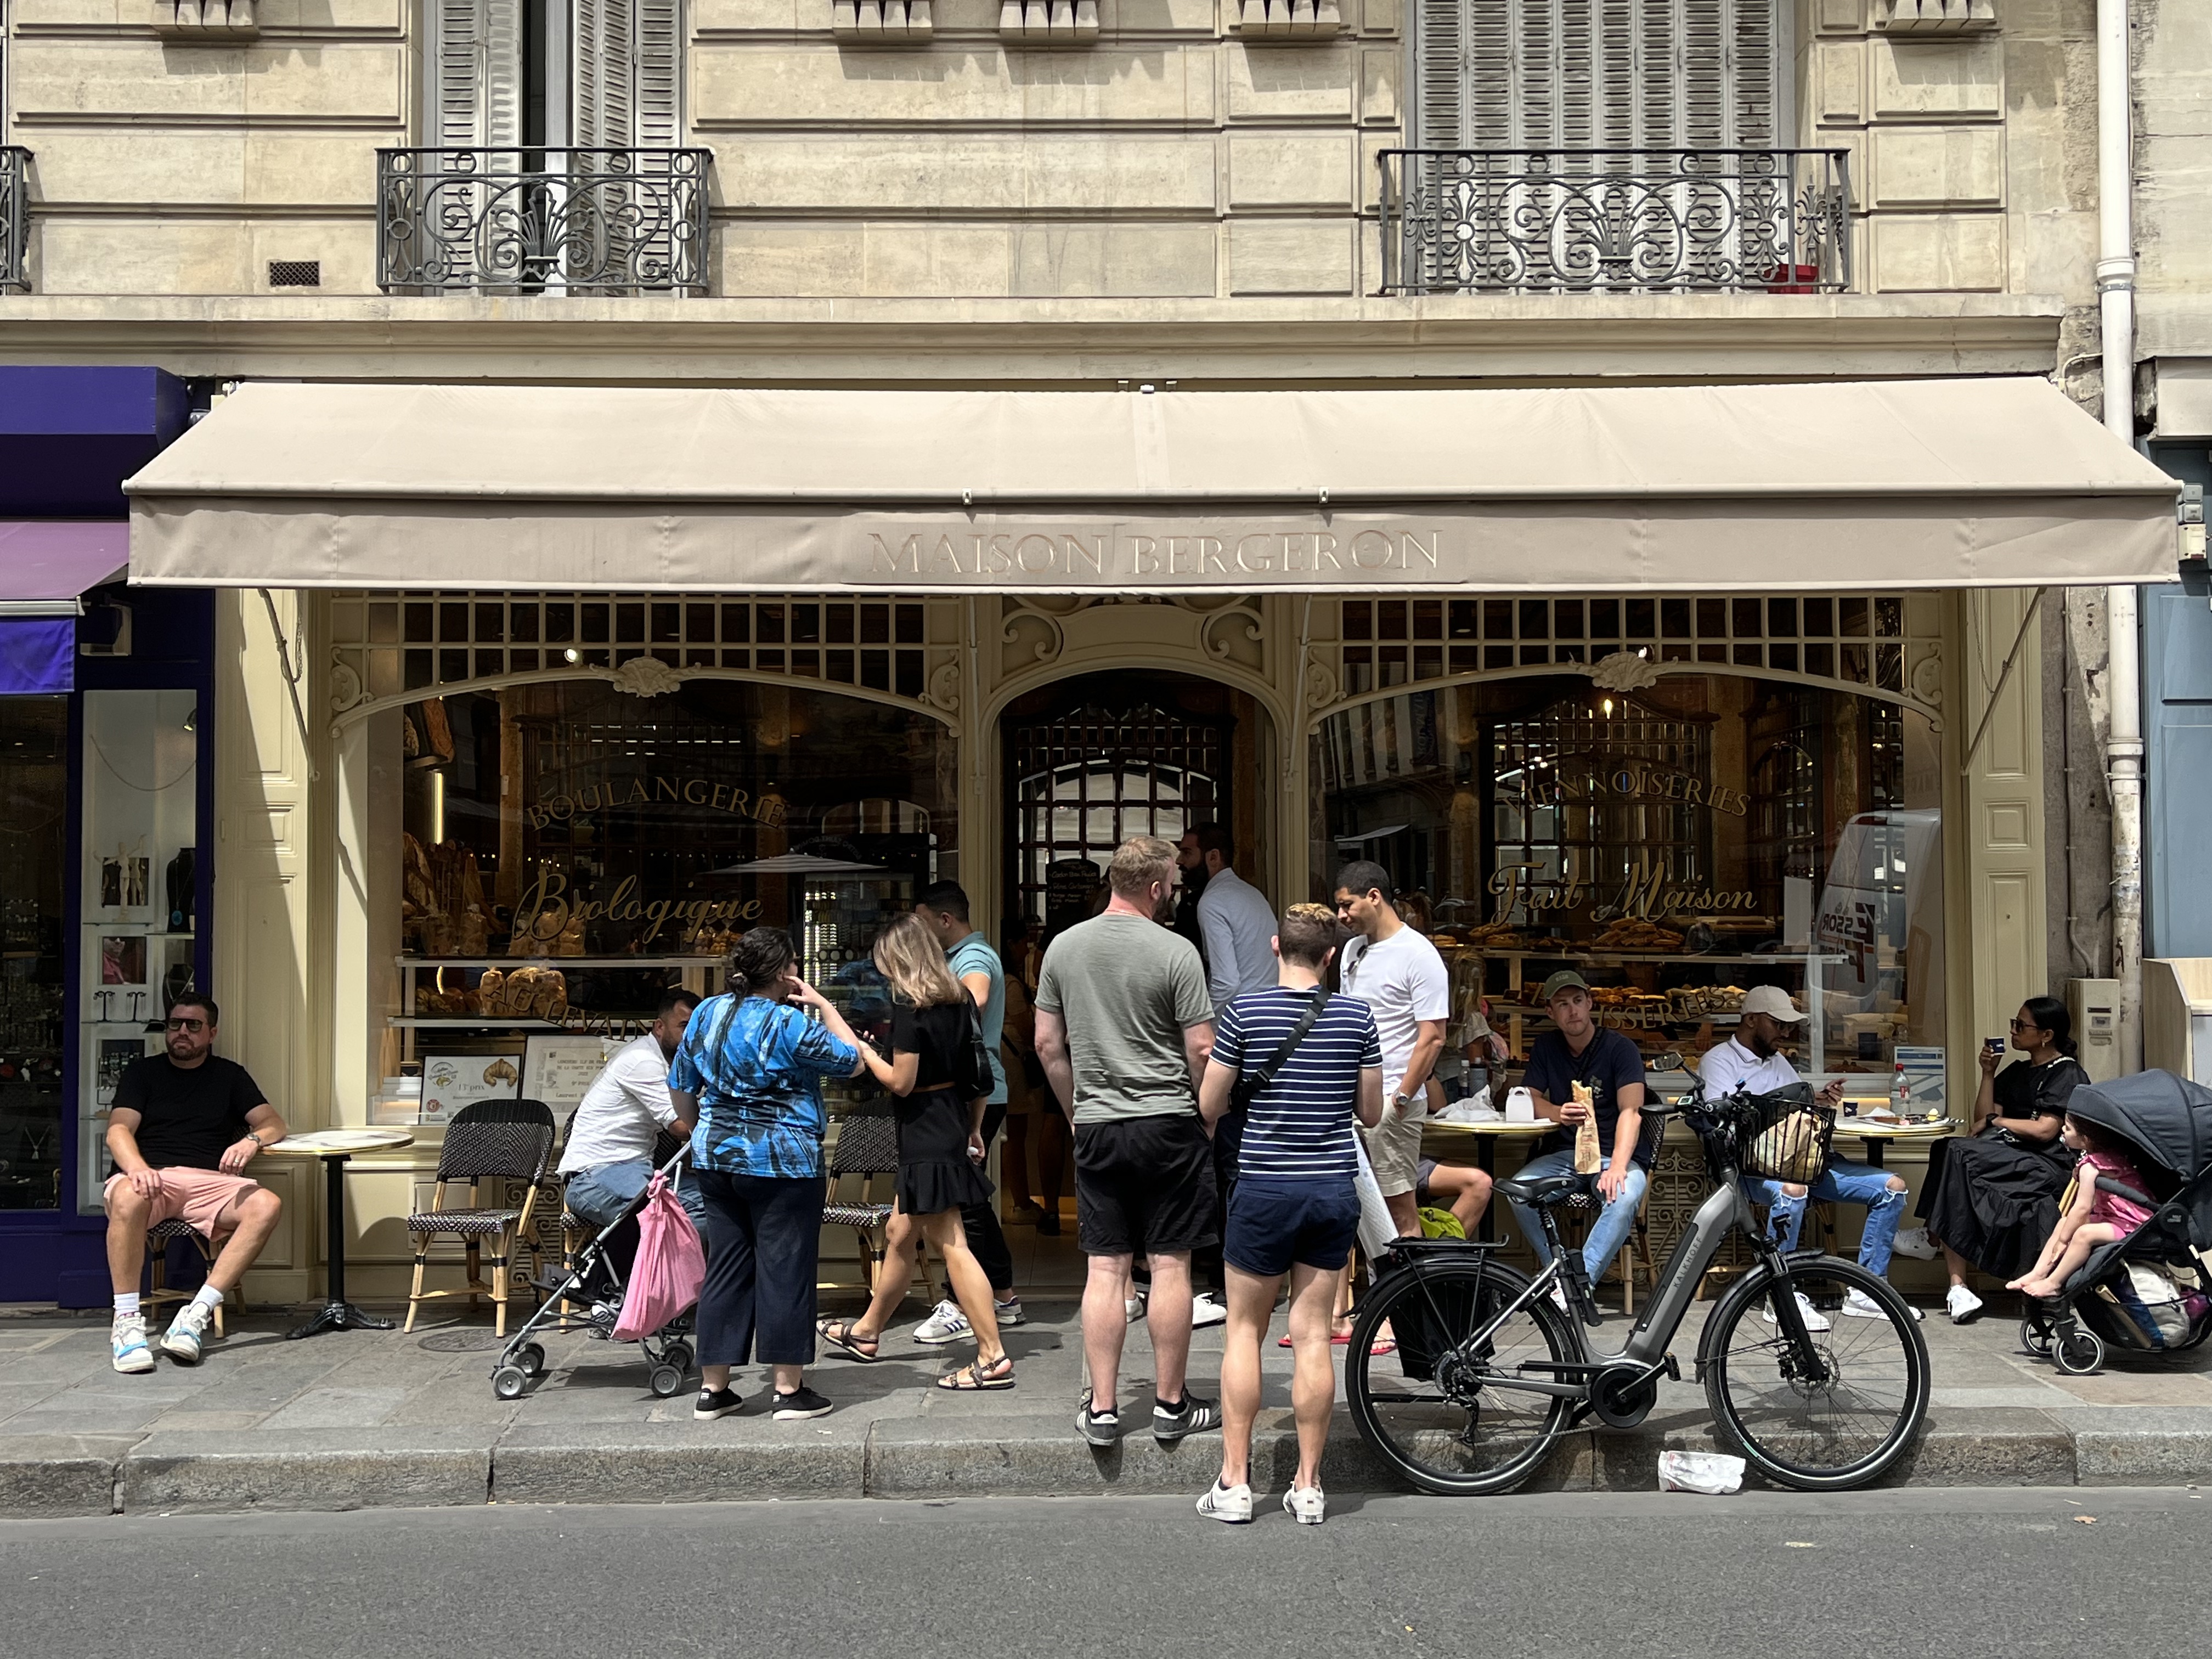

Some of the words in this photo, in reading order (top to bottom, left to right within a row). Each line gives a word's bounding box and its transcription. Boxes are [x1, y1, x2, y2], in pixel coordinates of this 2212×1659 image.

[867, 533, 1109, 575] MAISON
[1125, 529, 1443, 575] BERGERON
[525, 776, 786, 832] BOULANGERIE
[1499, 770, 1751, 817] VIENNOISERIES
[512, 867, 764, 944] Biologique
[1487, 861, 1584, 927] Fait
[1589, 861, 1758, 923] Maison
[486, 980, 540, 1012] AU
[1529, 982, 1725, 1030] ISSERIES
[1673, 1236, 1703, 1288] KALKHOFF
